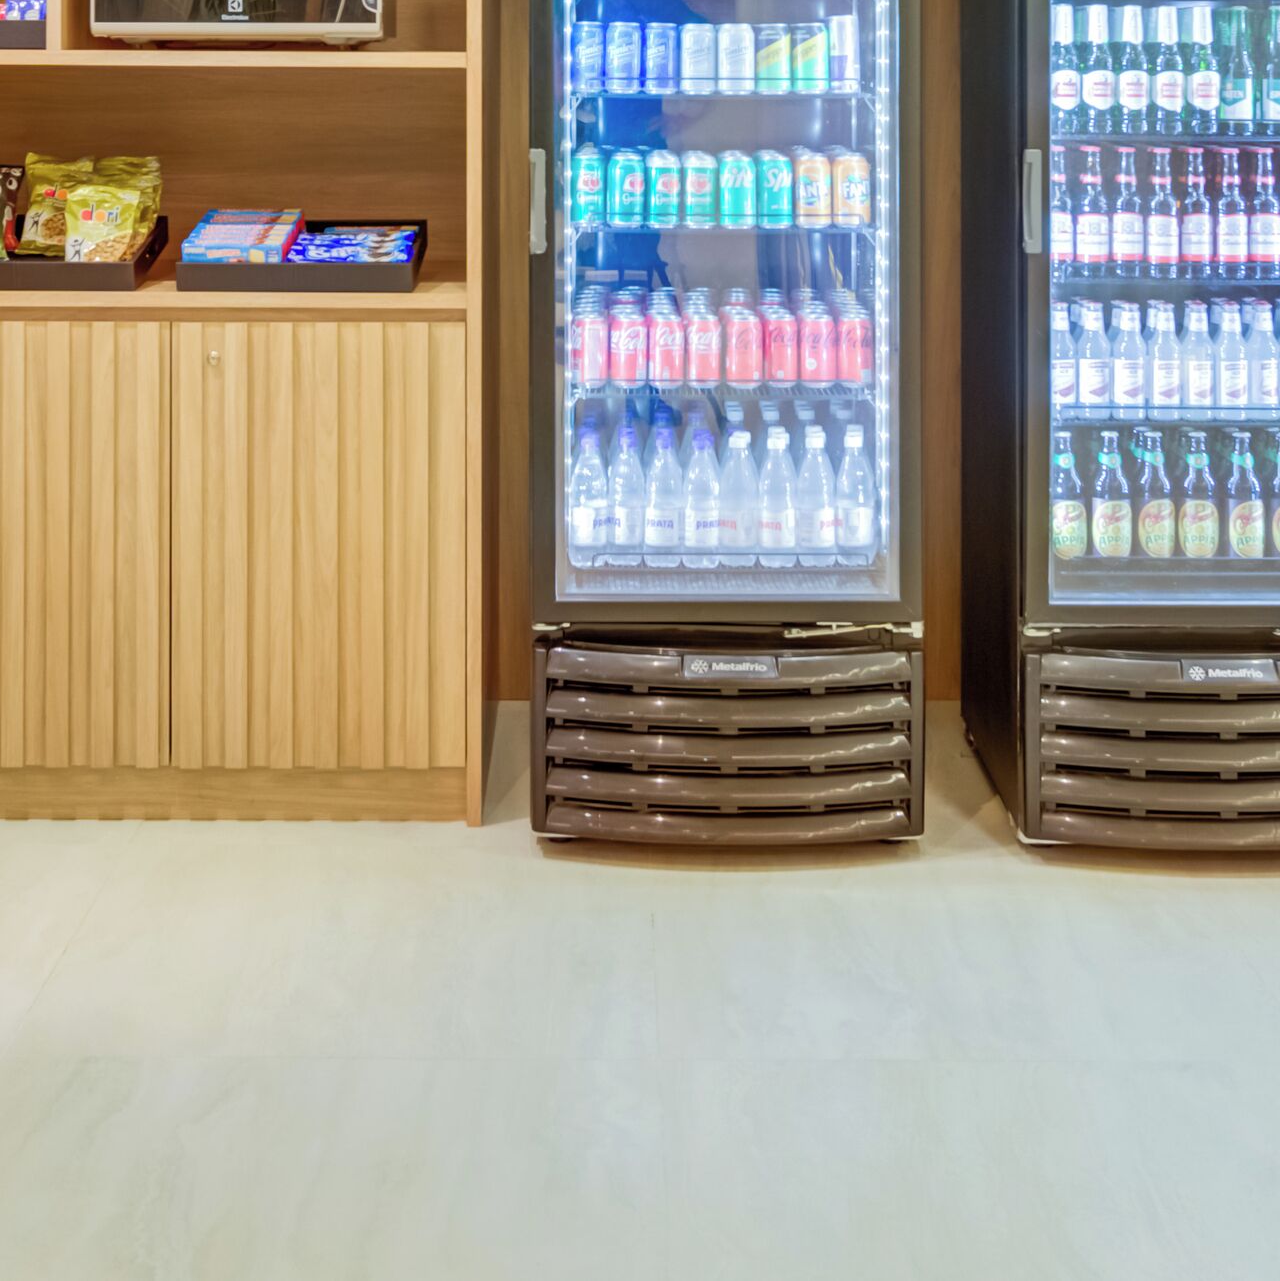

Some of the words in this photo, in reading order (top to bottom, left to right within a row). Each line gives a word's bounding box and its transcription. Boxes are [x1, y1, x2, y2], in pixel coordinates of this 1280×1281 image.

[80, 203, 120, 223] dori
[712, 662, 767, 672] Metalfrio
[1207, 668, 1264, 679] Metalfrio
